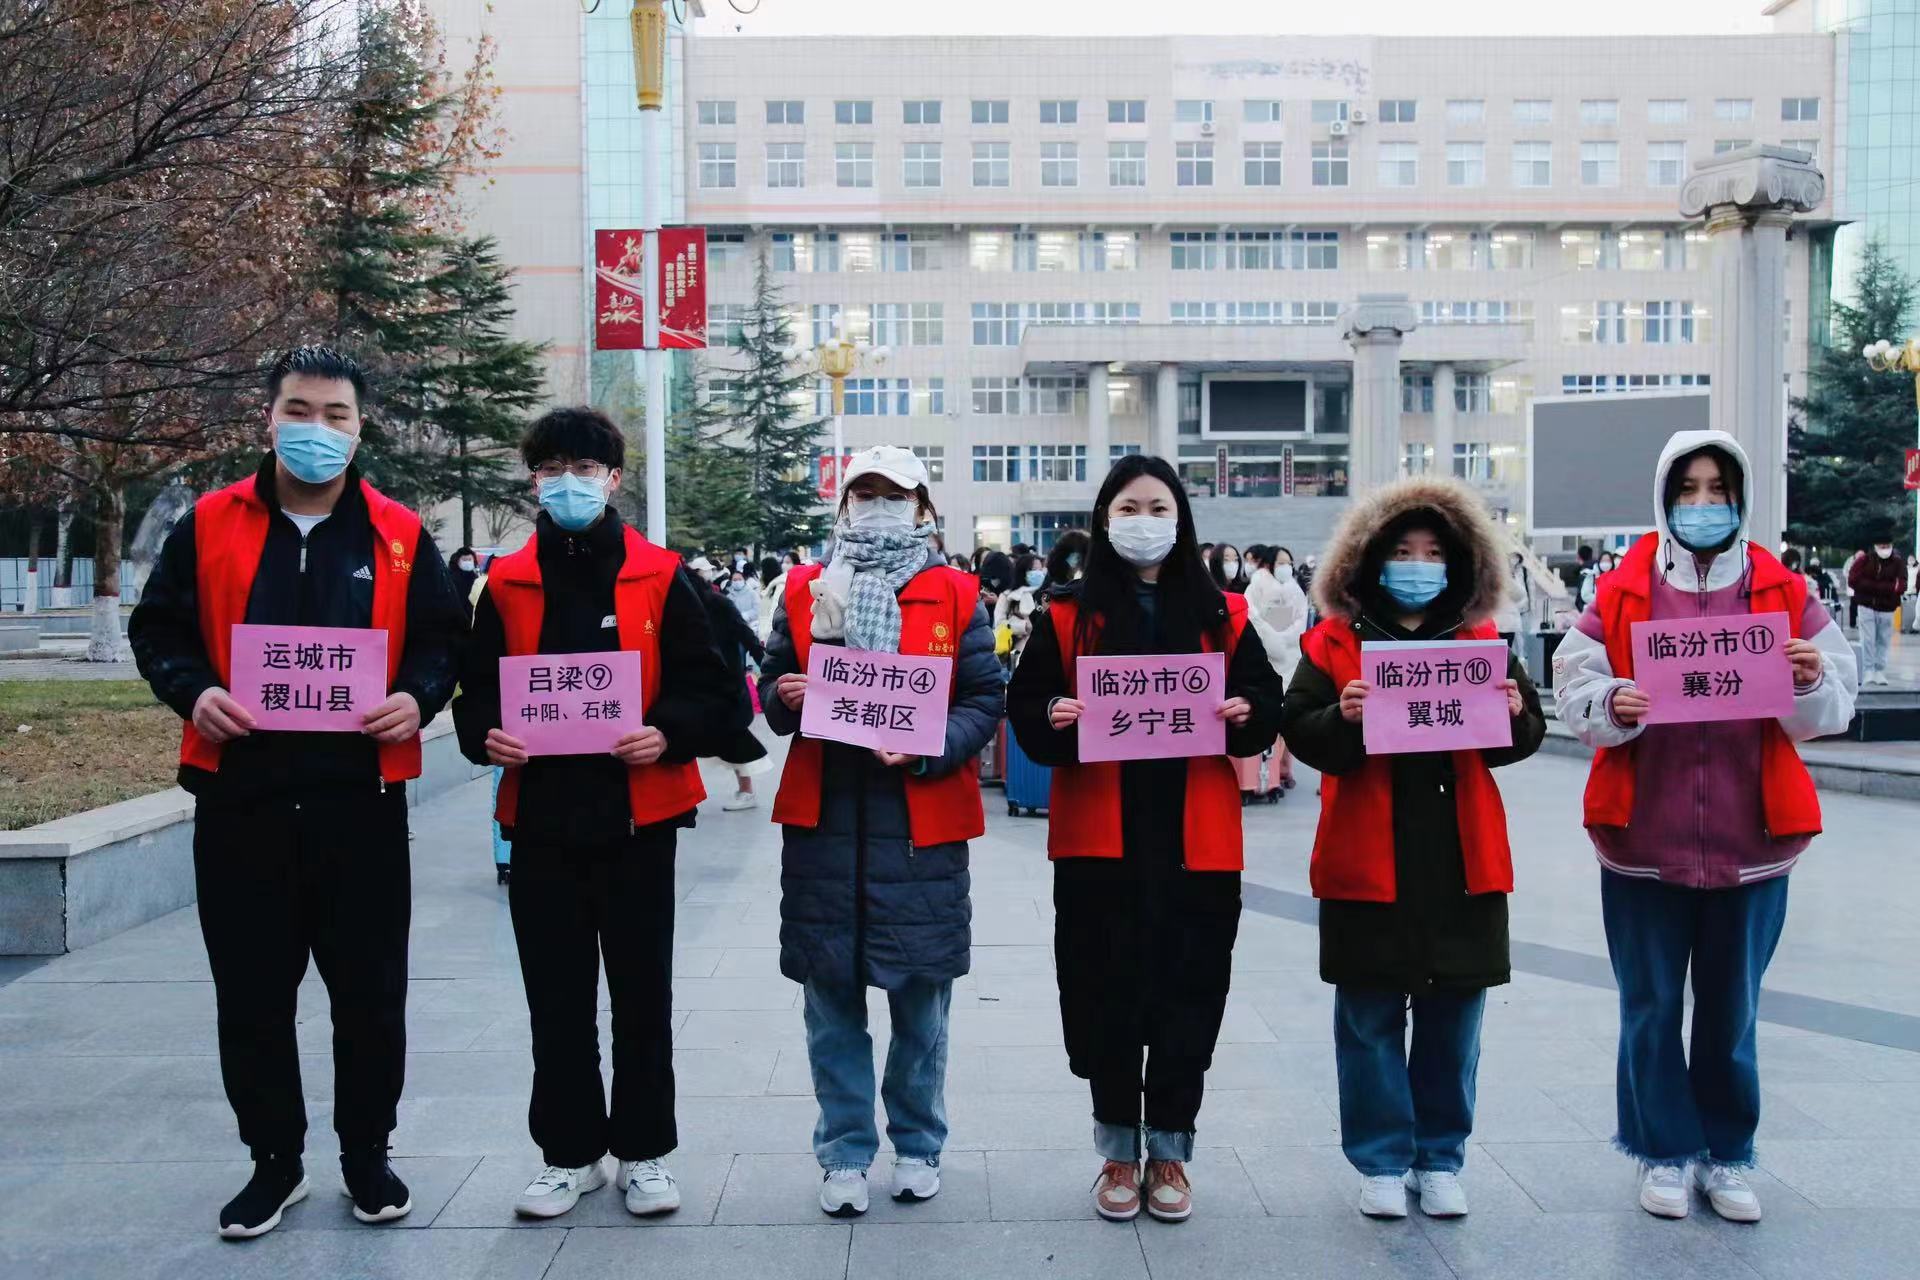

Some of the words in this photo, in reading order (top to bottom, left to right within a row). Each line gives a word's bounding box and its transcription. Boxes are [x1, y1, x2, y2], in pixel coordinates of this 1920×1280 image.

[263, 643, 356, 671] 运城市
[261, 683, 354, 712] 稷山县
[1682, 670, 1743, 698] 襄汾
[522, 700, 621, 722] 中阳、石楼
[831, 697, 916, 731] 尧都区
[1109, 708, 1195, 736] 乡宁县
[1408, 699, 1463, 728] 翼城
